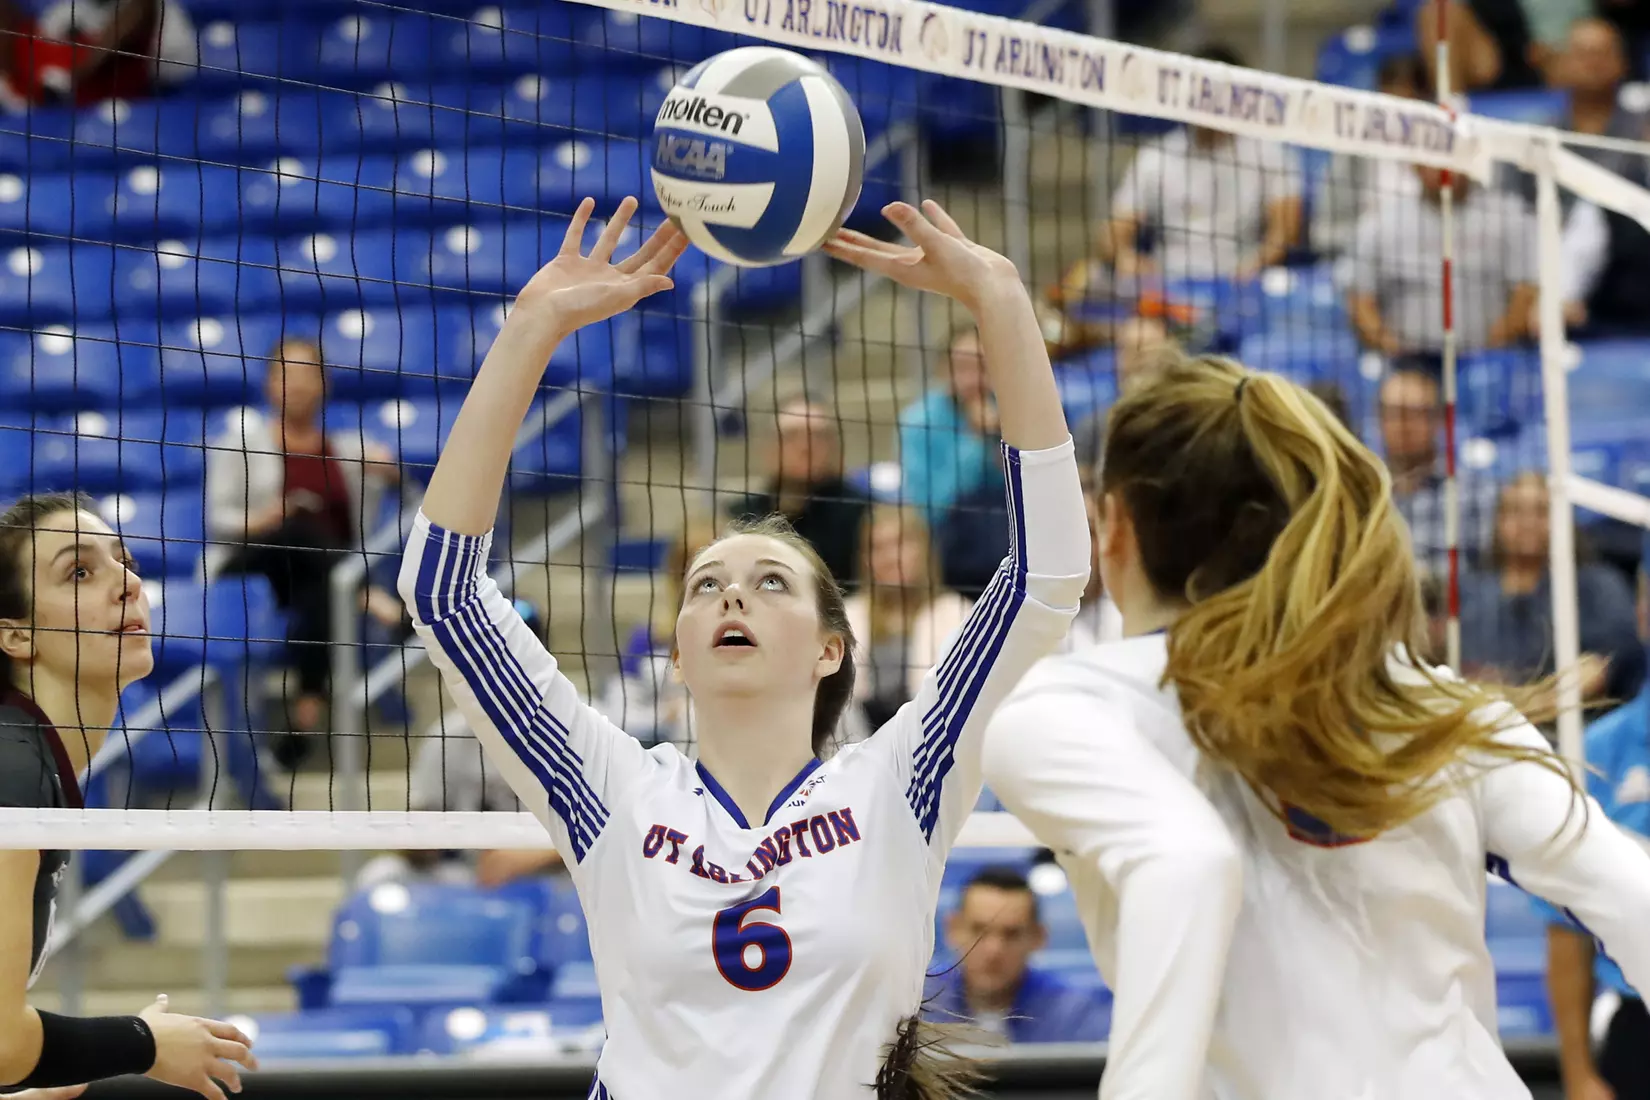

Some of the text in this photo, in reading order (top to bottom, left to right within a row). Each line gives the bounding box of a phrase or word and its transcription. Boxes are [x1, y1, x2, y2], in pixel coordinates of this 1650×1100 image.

[658, 96, 744, 135] molten
[655, 133, 726, 179] NCAA
[686, 193, 737, 213] Touch
[642, 823, 689, 865] UT
[711, 885, 793, 992] 6
